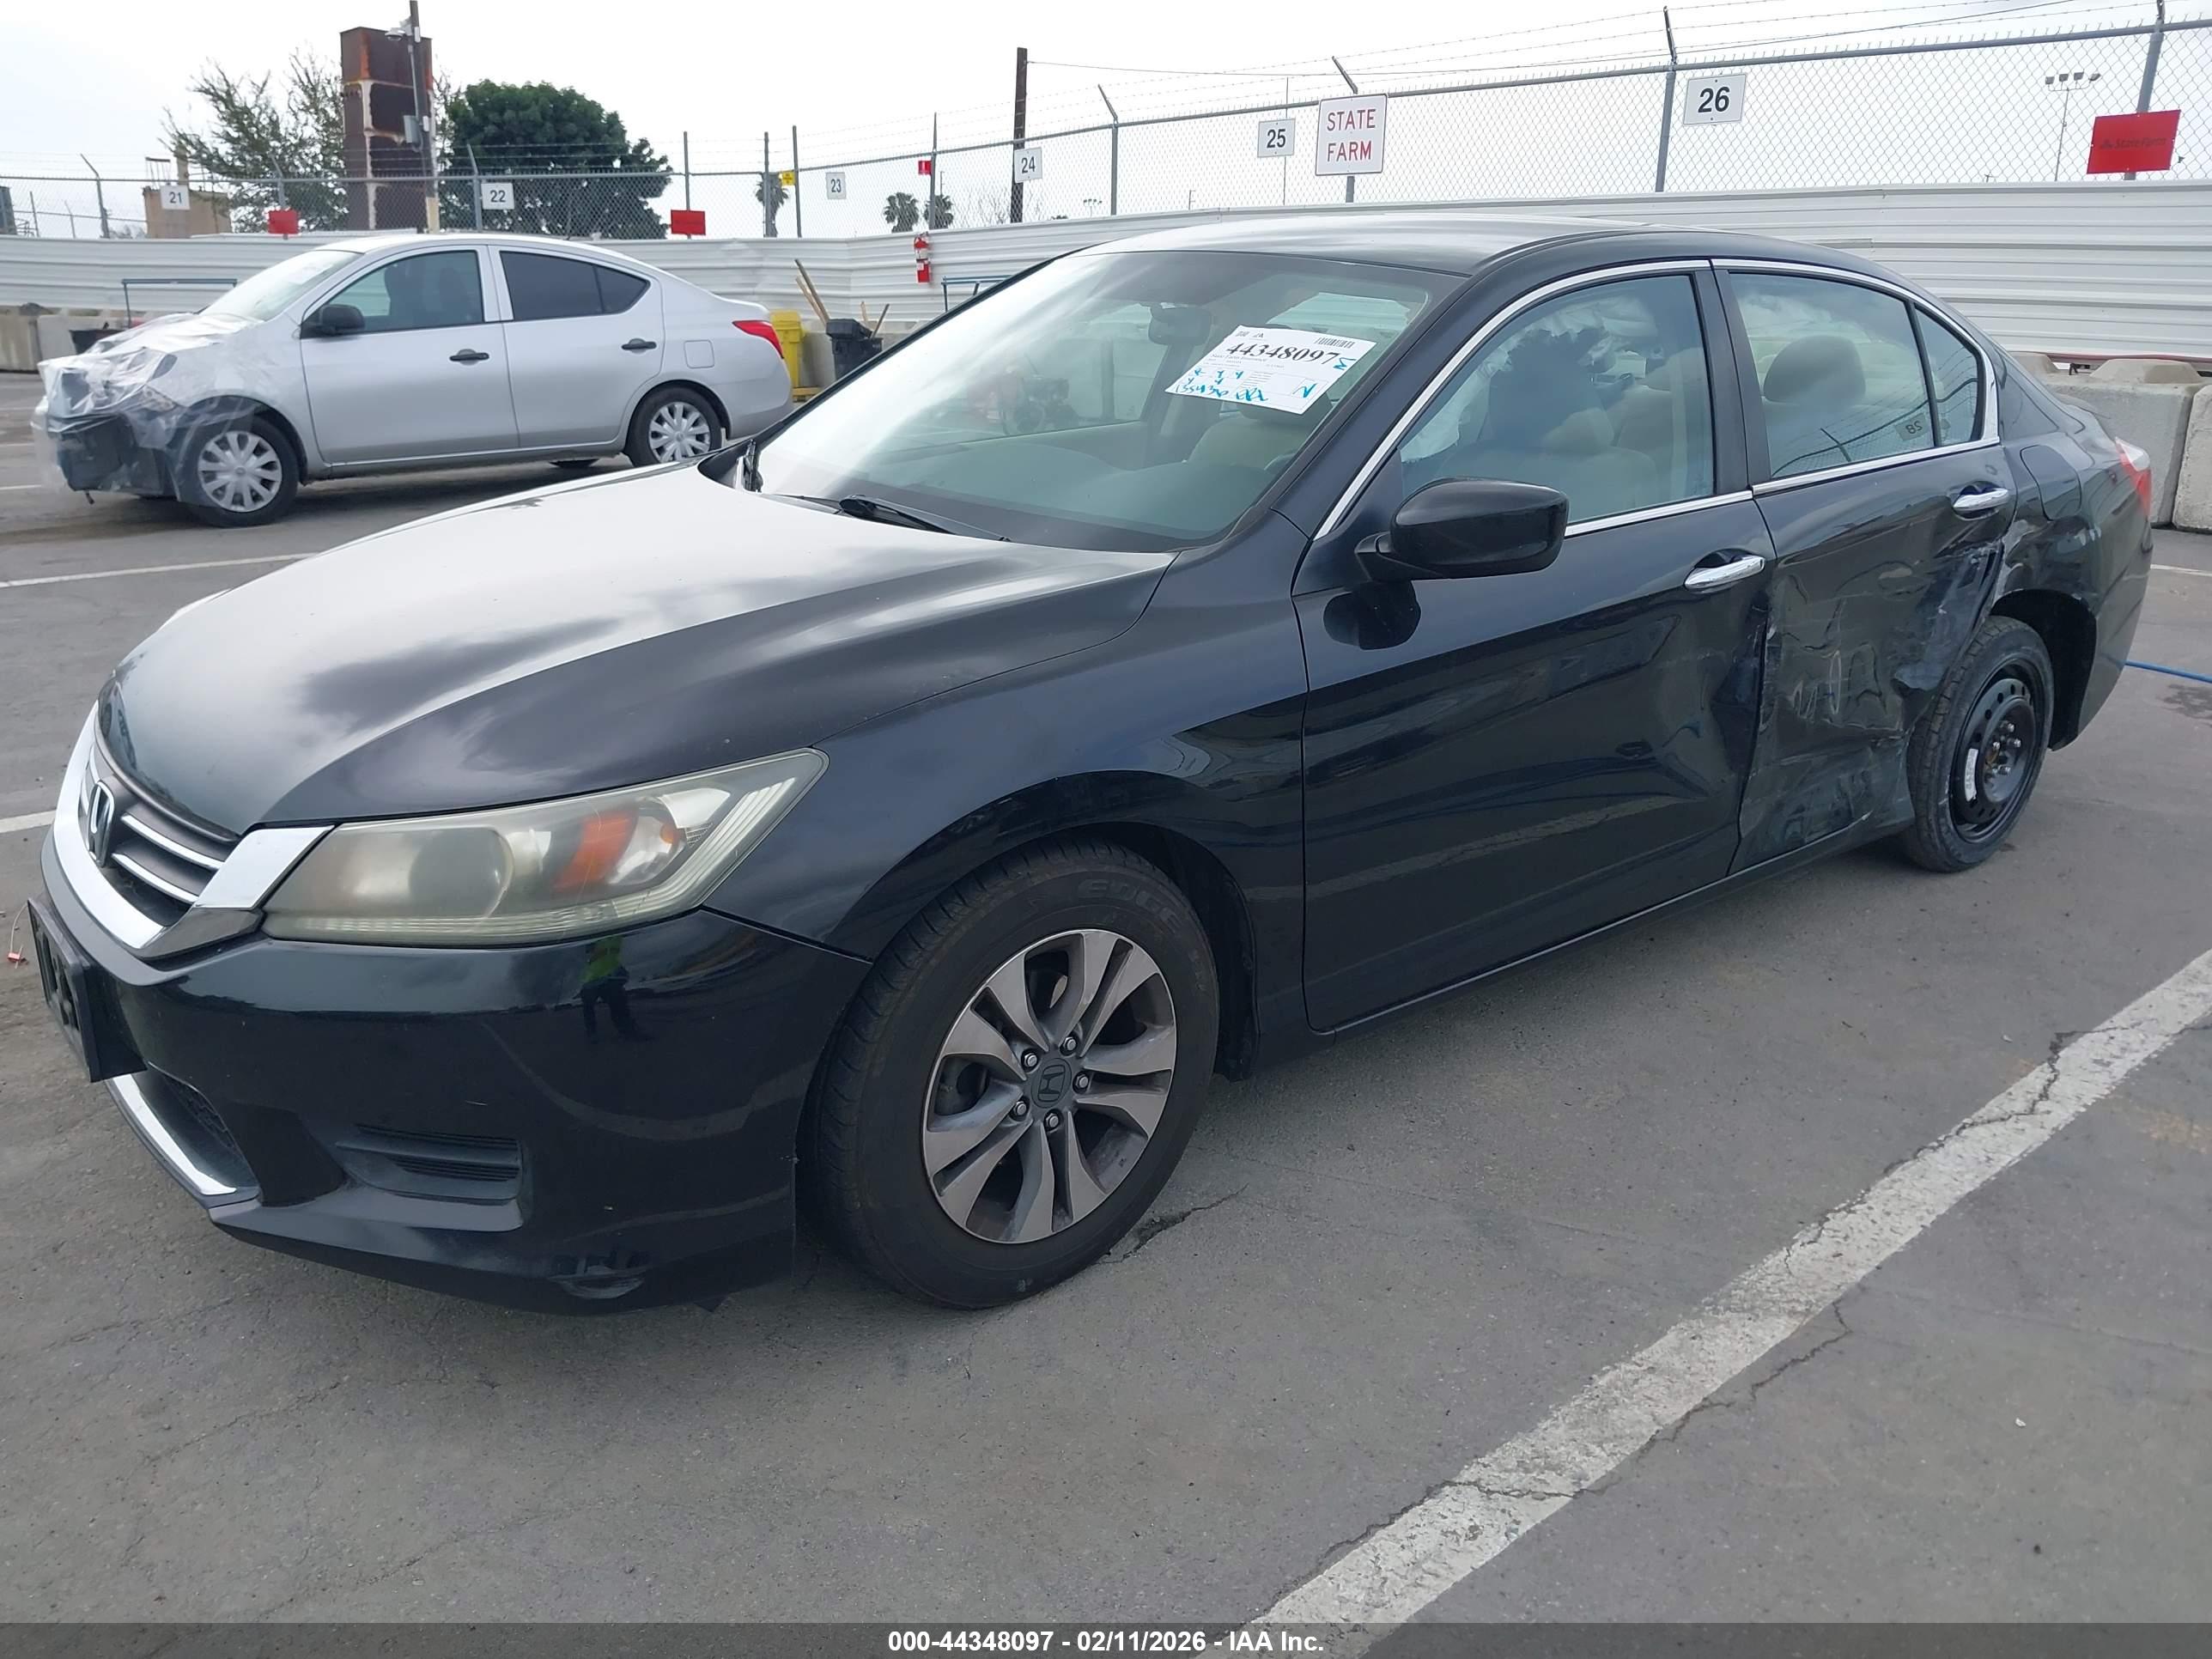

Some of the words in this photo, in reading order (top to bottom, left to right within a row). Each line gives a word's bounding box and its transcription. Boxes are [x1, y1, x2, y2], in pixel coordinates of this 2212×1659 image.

[1698, 87, 1730, 112] 26
[1327, 109, 1376, 131] STATE
[1267, 129, 1286, 149] 25
[1327, 140, 1372, 162] FARM
[1021, 156, 1036, 173] 24
[489, 189, 507, 203] 22
[830, 179, 842, 193] 23
[169, 191, 182, 204] 21
[1226, 343, 1340, 364] 44348097
